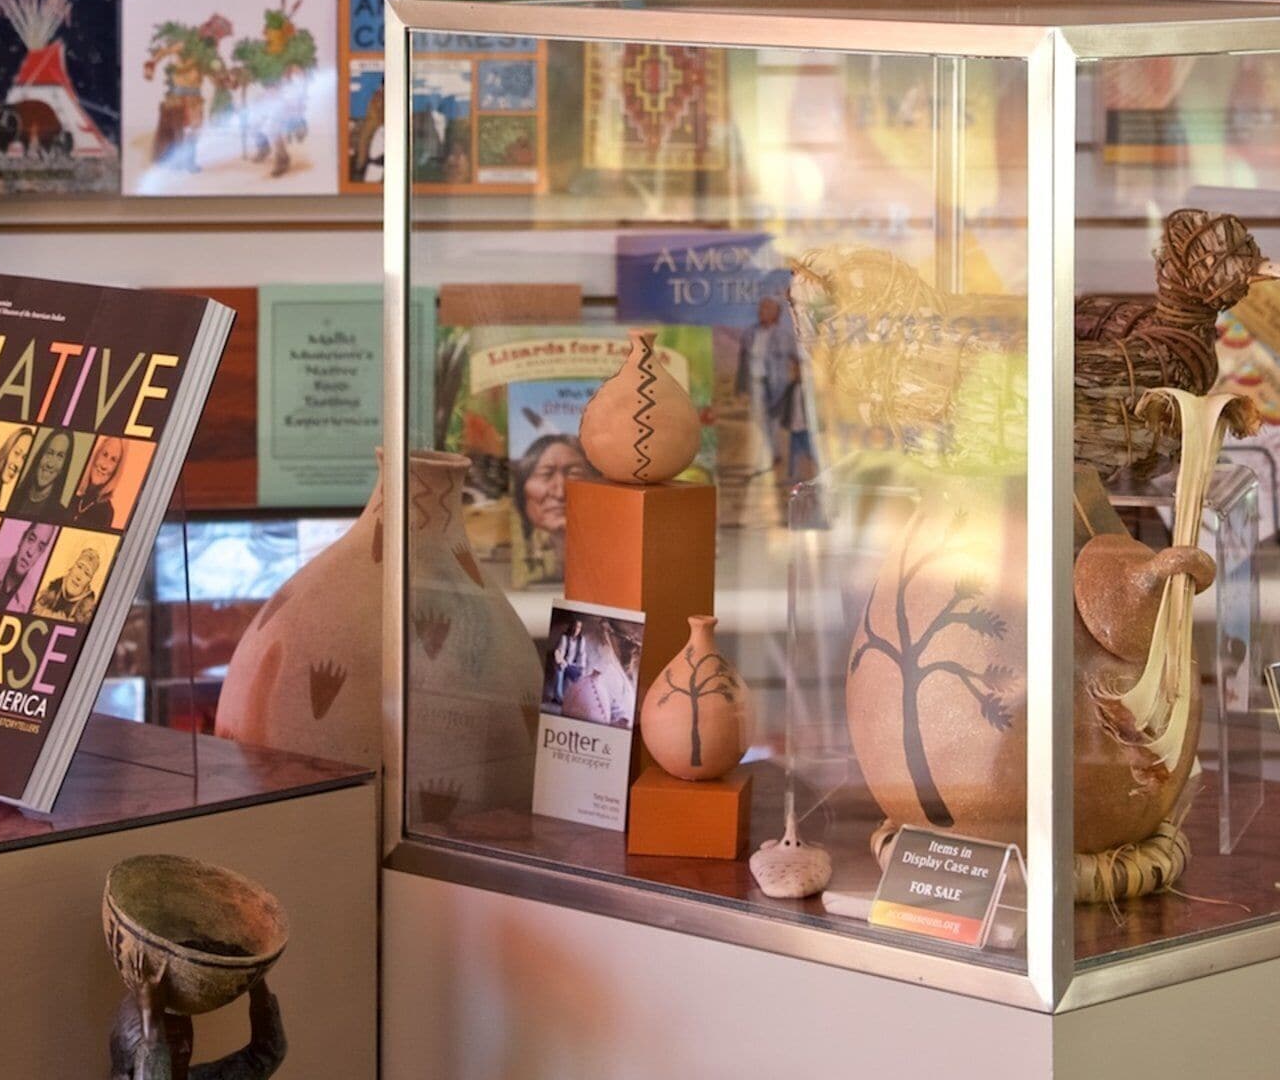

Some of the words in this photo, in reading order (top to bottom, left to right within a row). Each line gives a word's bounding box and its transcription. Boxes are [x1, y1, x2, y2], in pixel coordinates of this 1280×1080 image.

[487, 340, 565, 366] Lizards
[568, 339, 598, 357] for
[605, 339, 673, 366] Luh
[543, 728, 600, 754] potter
[601, 744, 612, 756] &
[928, 840, 959, 857] Items
[960, 846, 973, 859] in
[902, 851, 942, 872] Display
[943, 858, 970, 874] Case
[970, 867, 990, 879] are
[909, 880, 932, 896] FOR
[933, 885, 963, 902] SALE
